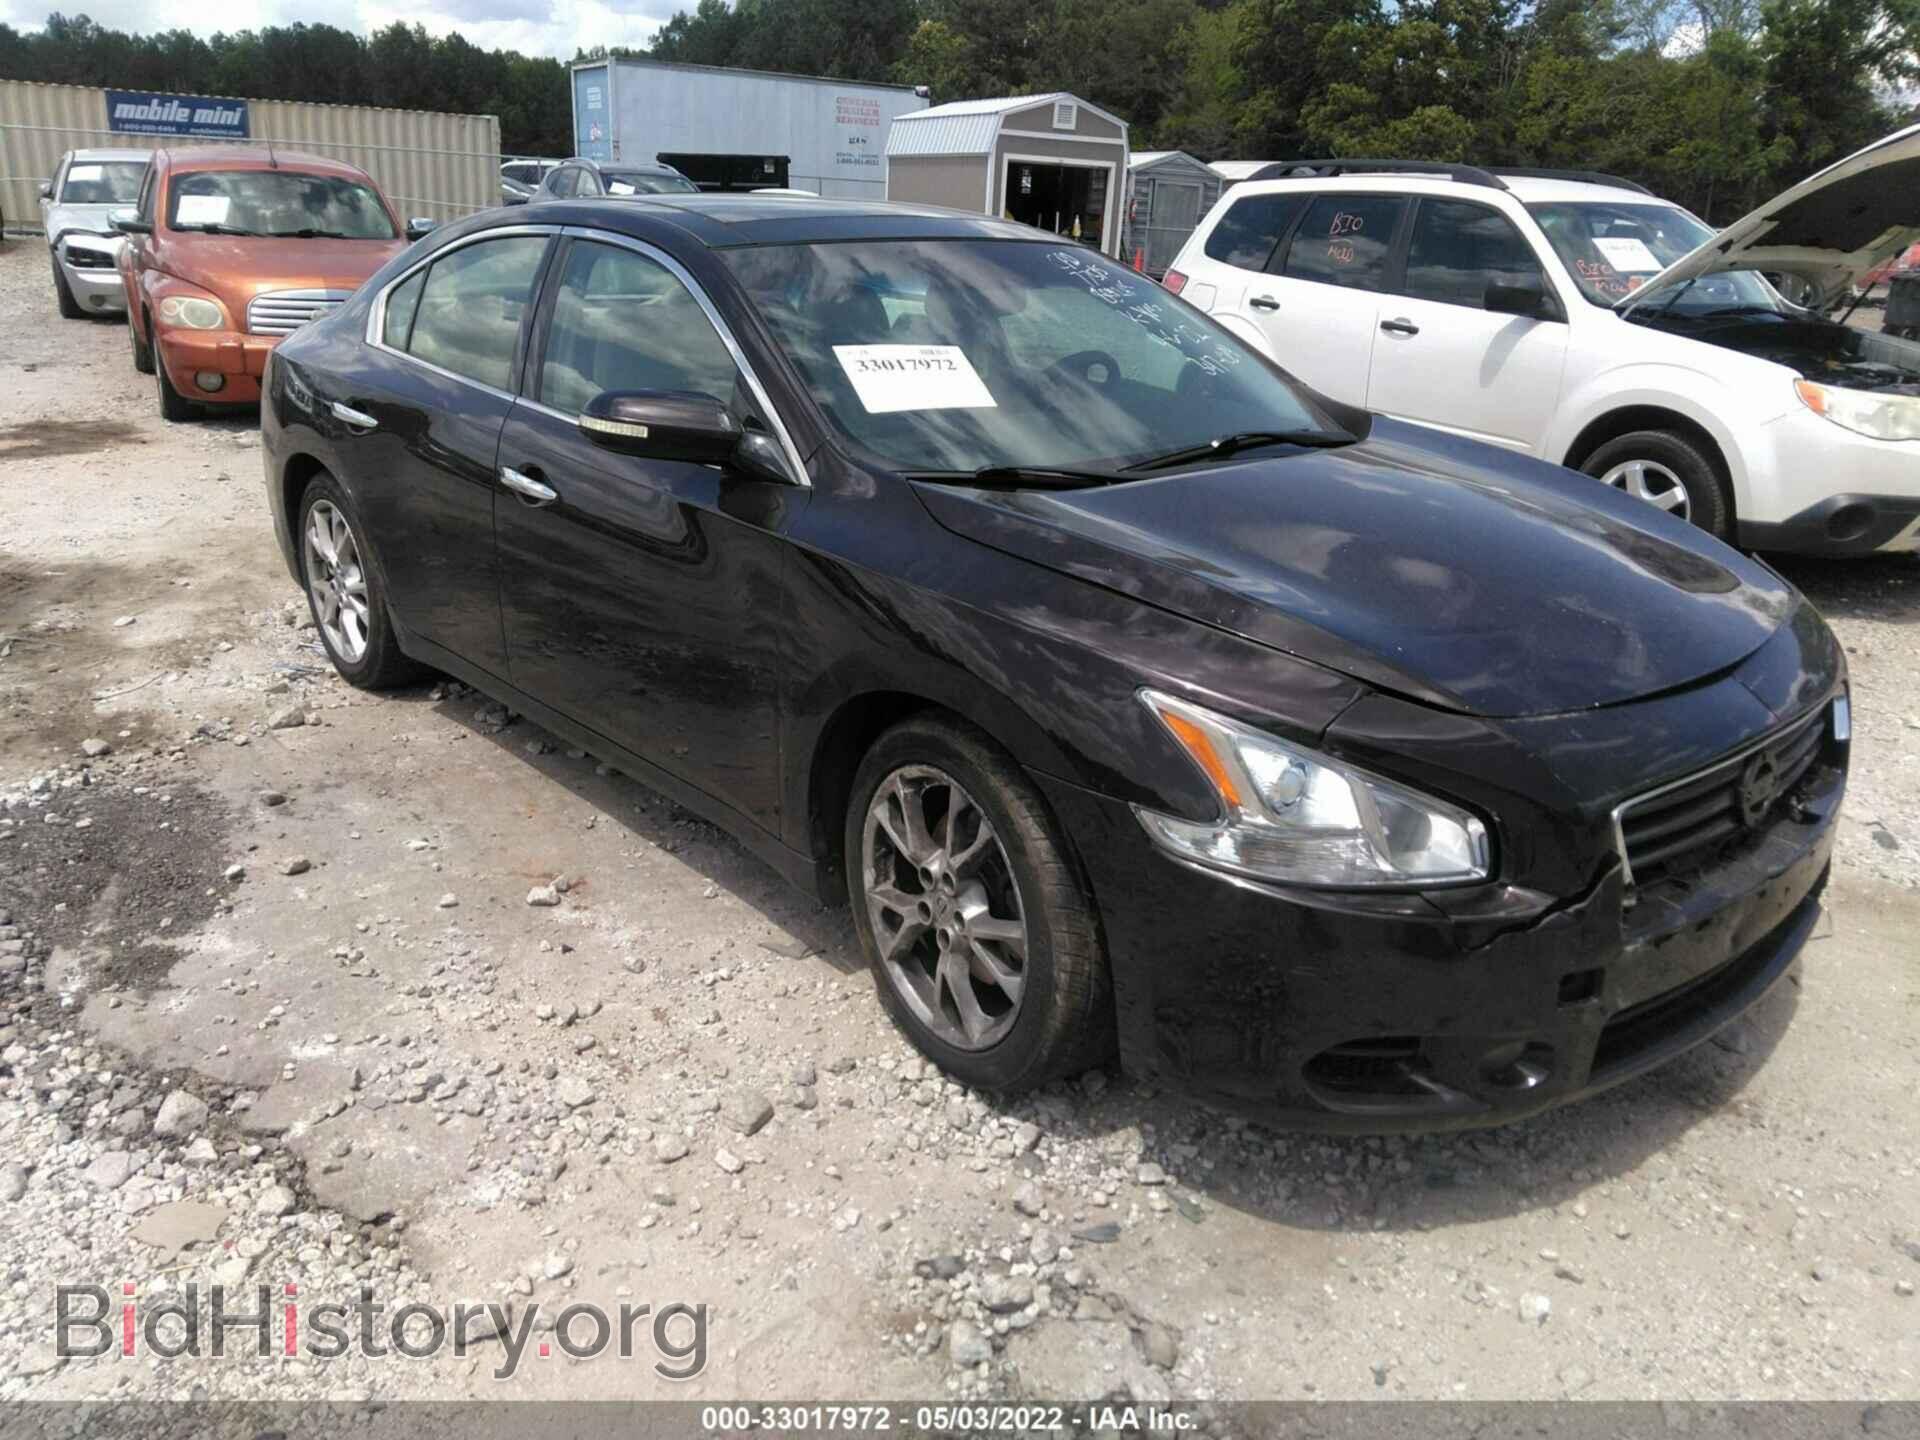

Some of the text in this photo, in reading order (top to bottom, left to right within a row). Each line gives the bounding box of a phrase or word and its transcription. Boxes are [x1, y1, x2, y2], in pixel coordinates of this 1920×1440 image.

[114, 98, 245, 125] mobile mini
[856, 359, 957, 372] 33017972
